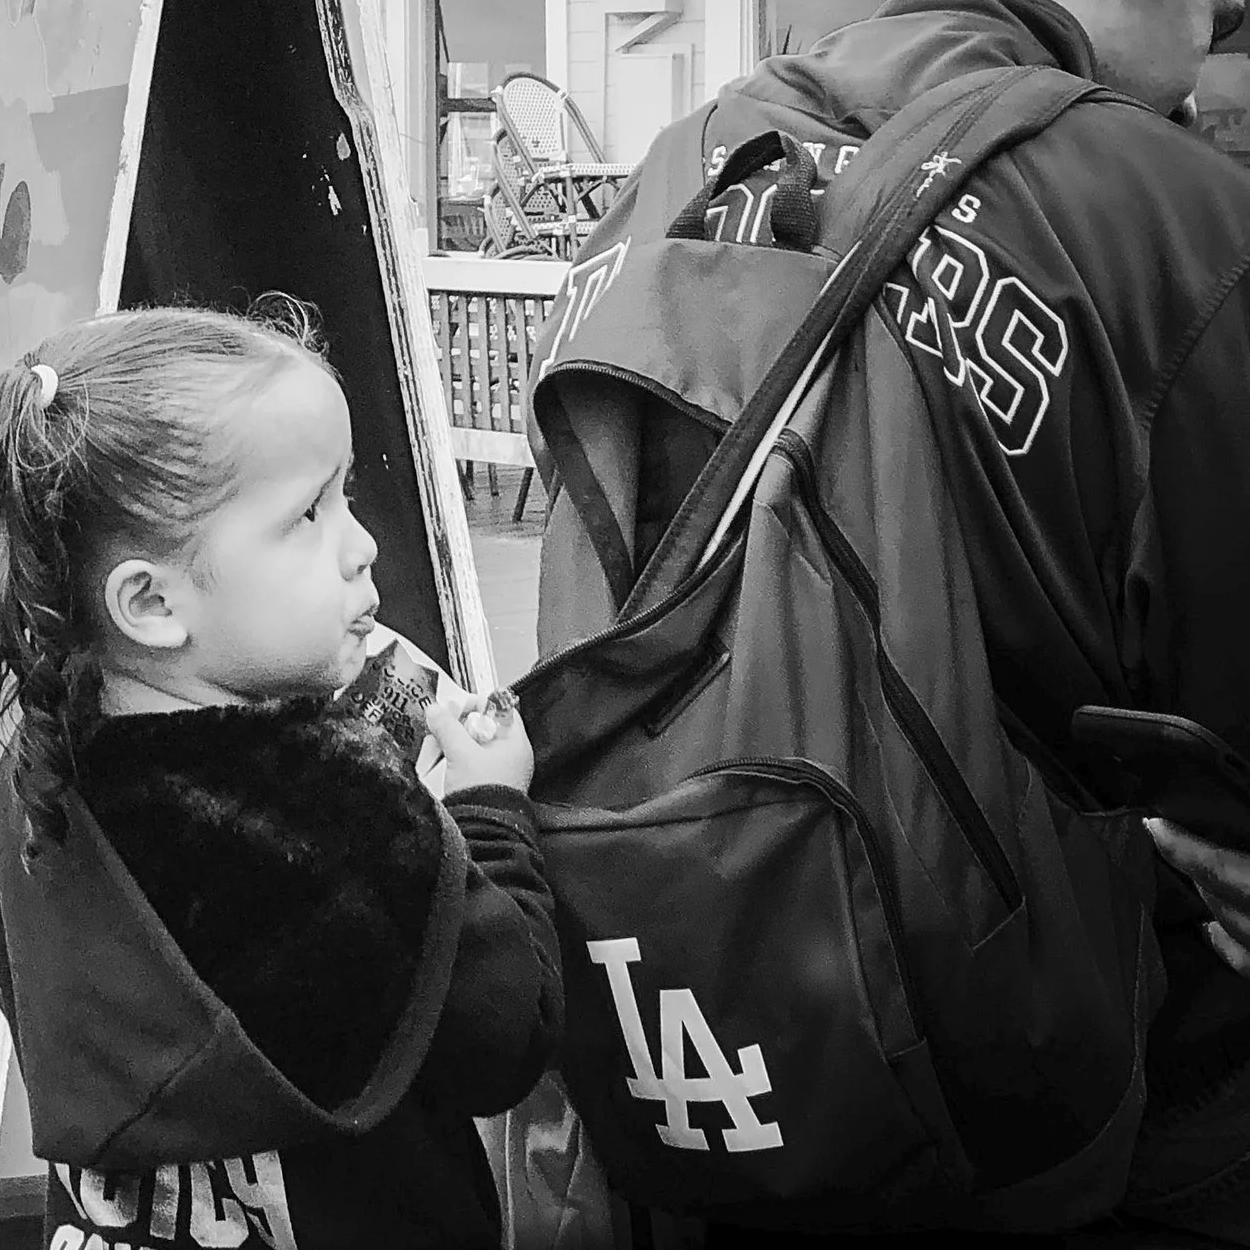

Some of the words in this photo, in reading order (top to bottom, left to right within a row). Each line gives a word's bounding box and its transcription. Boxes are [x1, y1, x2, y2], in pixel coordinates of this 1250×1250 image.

[381, 686, 409, 713] 911
[586, 936, 785, 1153] LA
[53, 1149, 300, 1250] UICY
